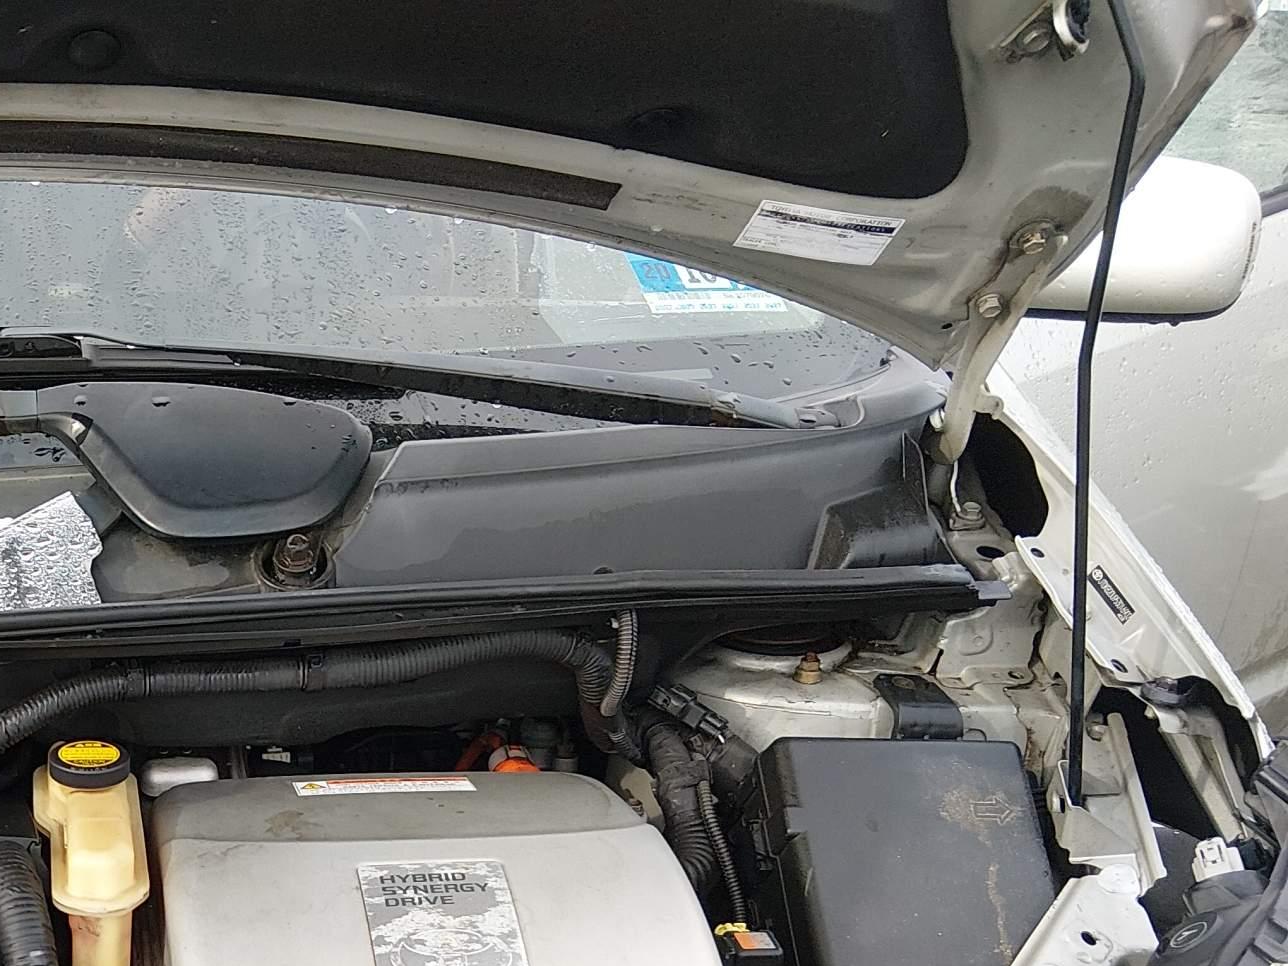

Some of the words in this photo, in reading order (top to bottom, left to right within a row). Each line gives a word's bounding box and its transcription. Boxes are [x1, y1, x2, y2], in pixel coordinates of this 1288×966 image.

[380, 872, 466, 884] HYBRID
[381, 883, 489, 895] SYNERGY
[385, 895, 455, 907] DRIVE
